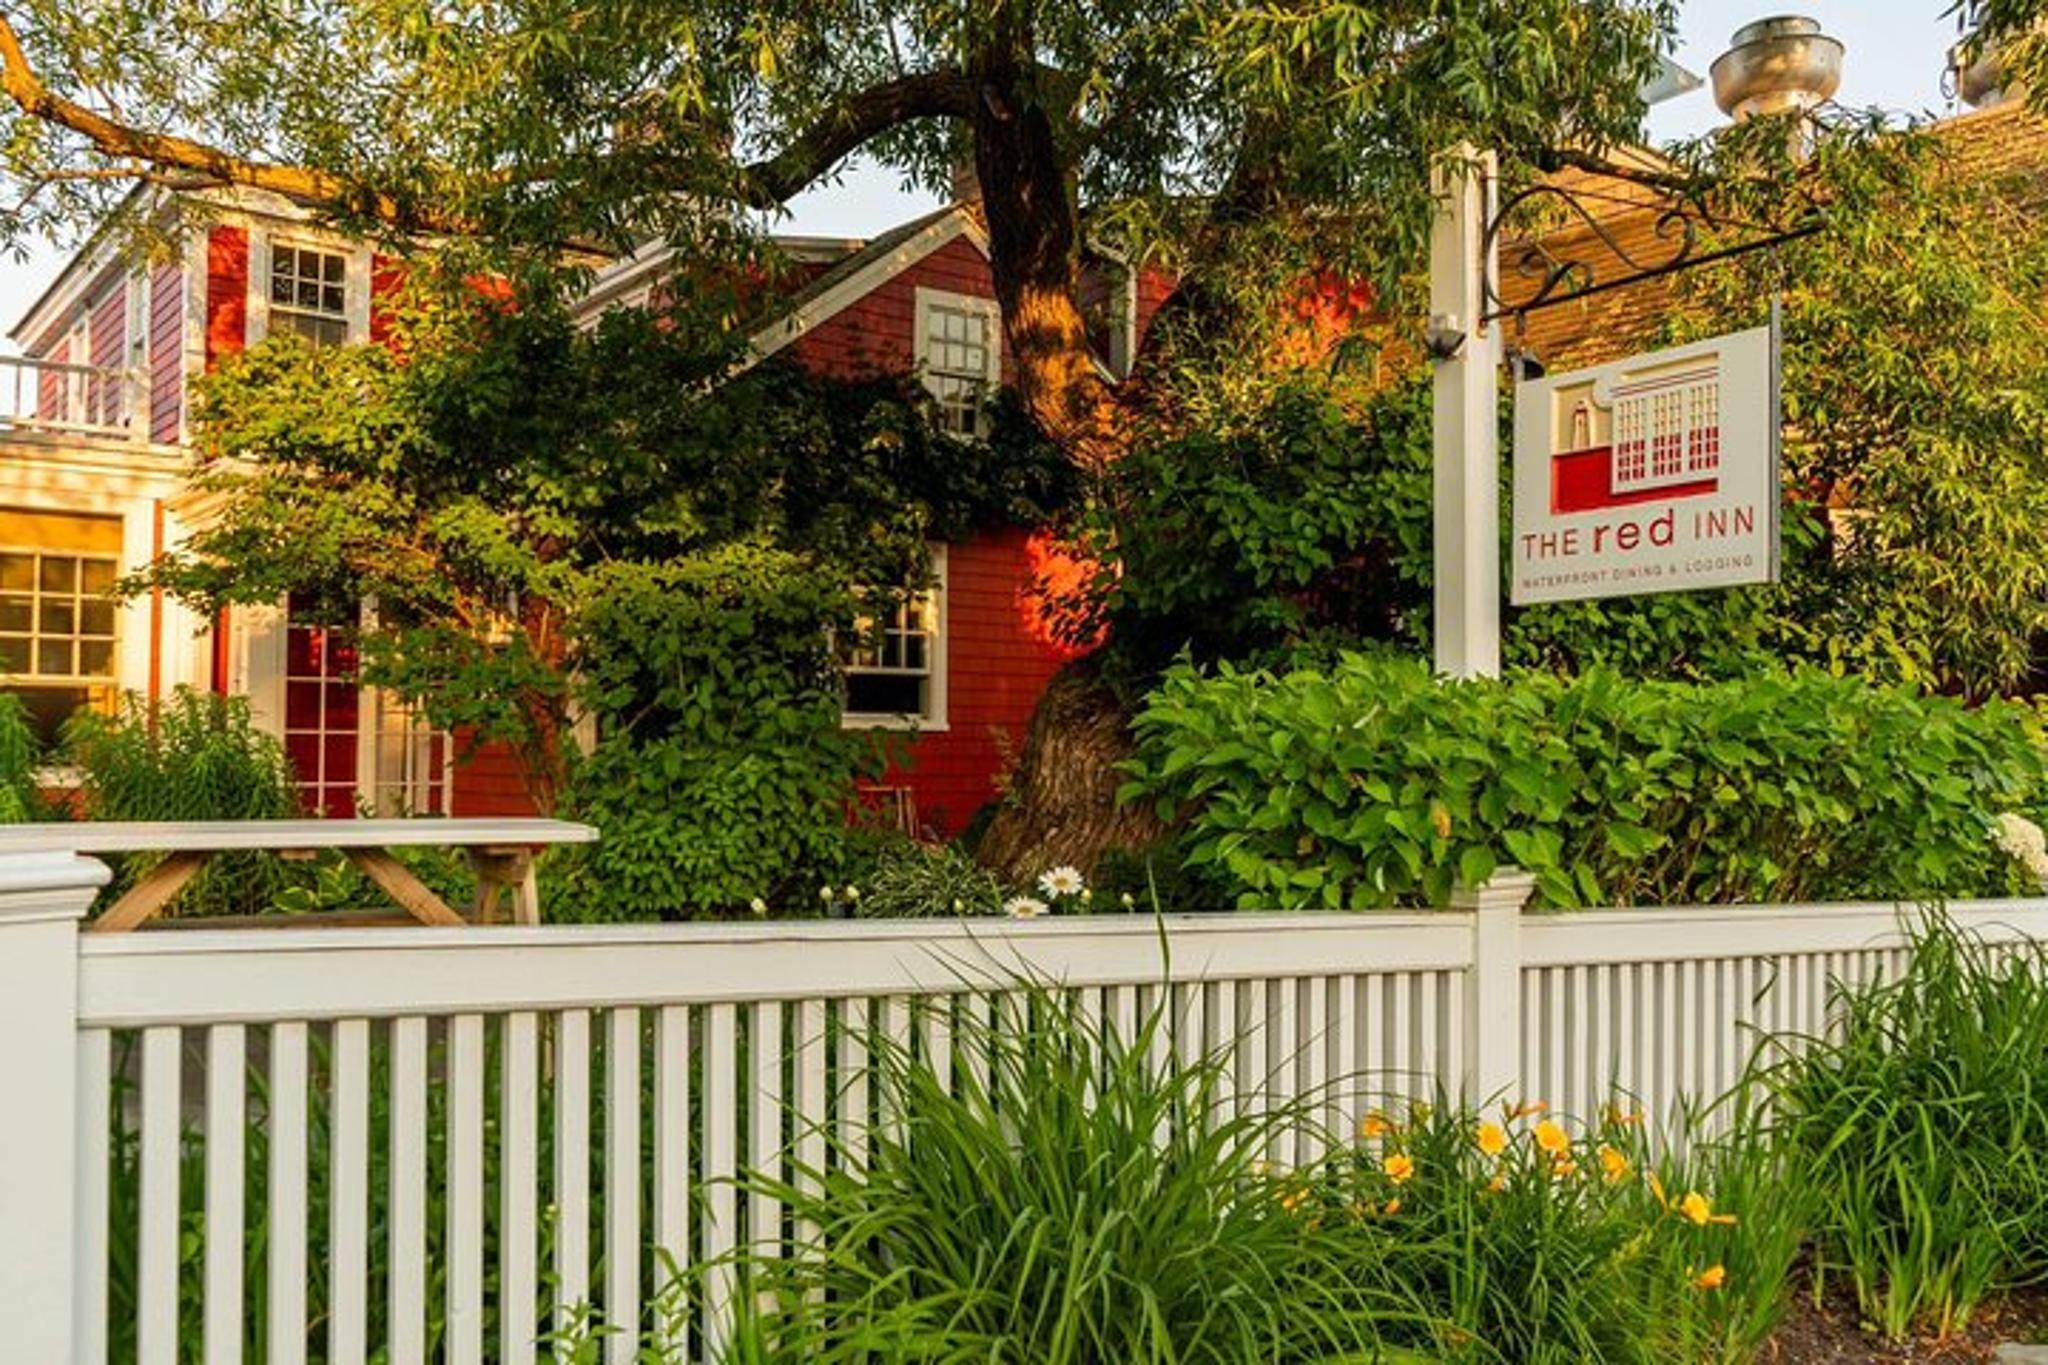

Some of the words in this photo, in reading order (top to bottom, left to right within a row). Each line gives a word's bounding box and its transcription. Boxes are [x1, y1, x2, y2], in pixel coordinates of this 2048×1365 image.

[1521, 532, 1578, 560] THE
[1593, 507, 1673, 553] red
[1695, 506, 1753, 540] INN
[1522, 569, 1606, 589] WATERFRONT
[1612, 565, 1662, 581] DINING
[1685, 554, 1753, 574] LODGING
